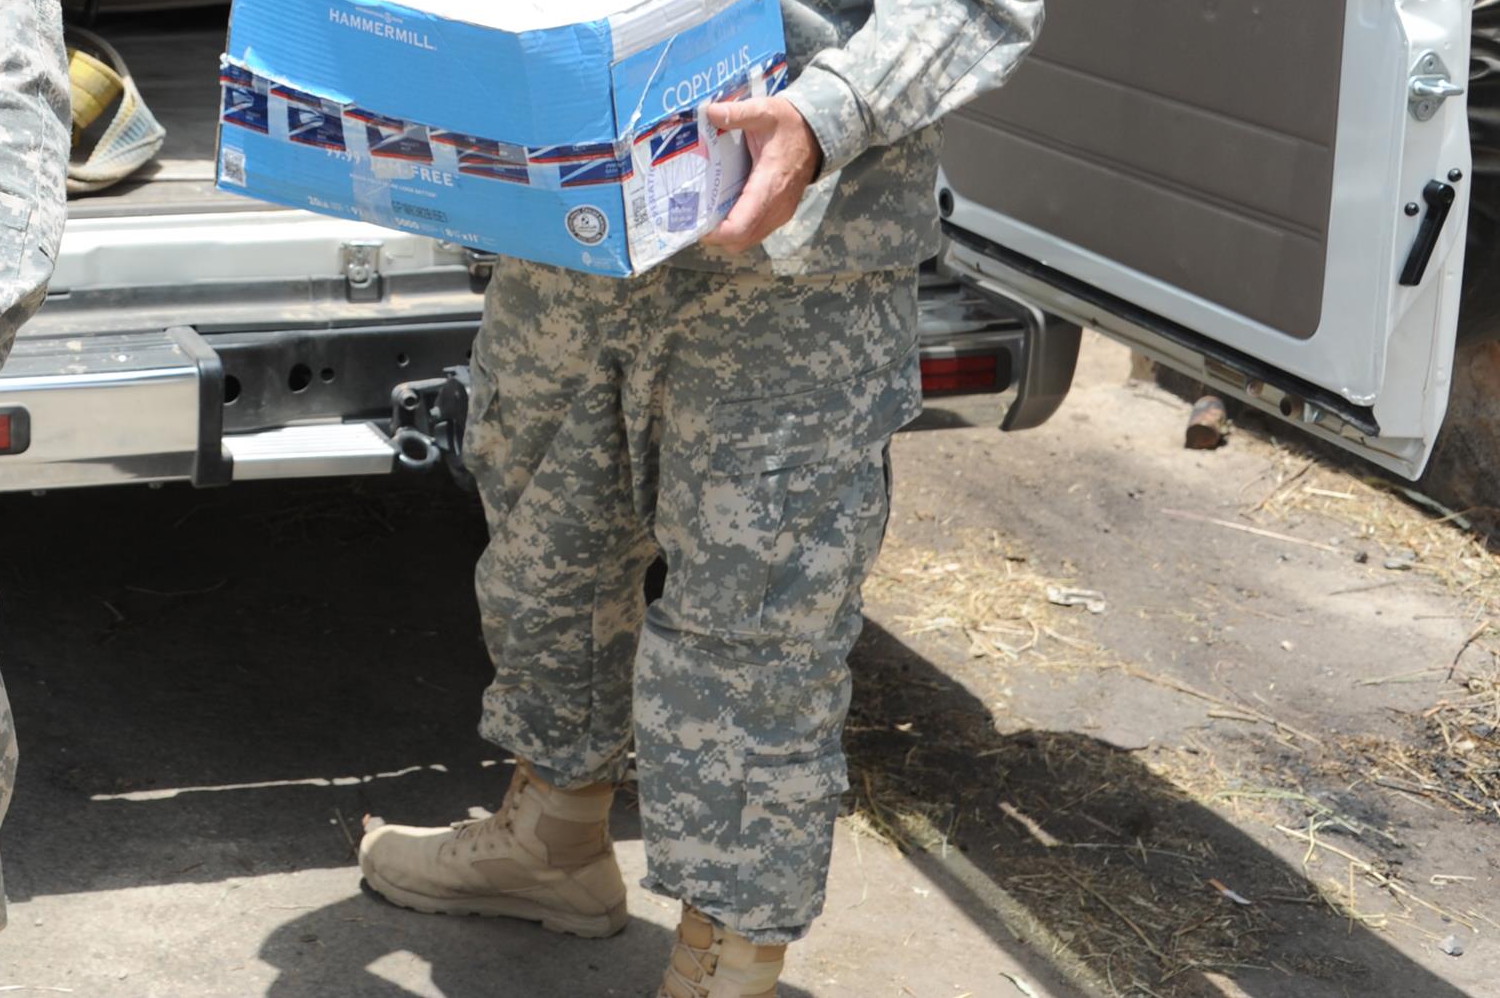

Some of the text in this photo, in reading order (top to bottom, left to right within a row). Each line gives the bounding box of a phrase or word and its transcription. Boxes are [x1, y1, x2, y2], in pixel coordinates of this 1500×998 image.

[329, 8, 436, 50] HAMMERMILL
[663, 45, 751, 113] COPY PLUS
